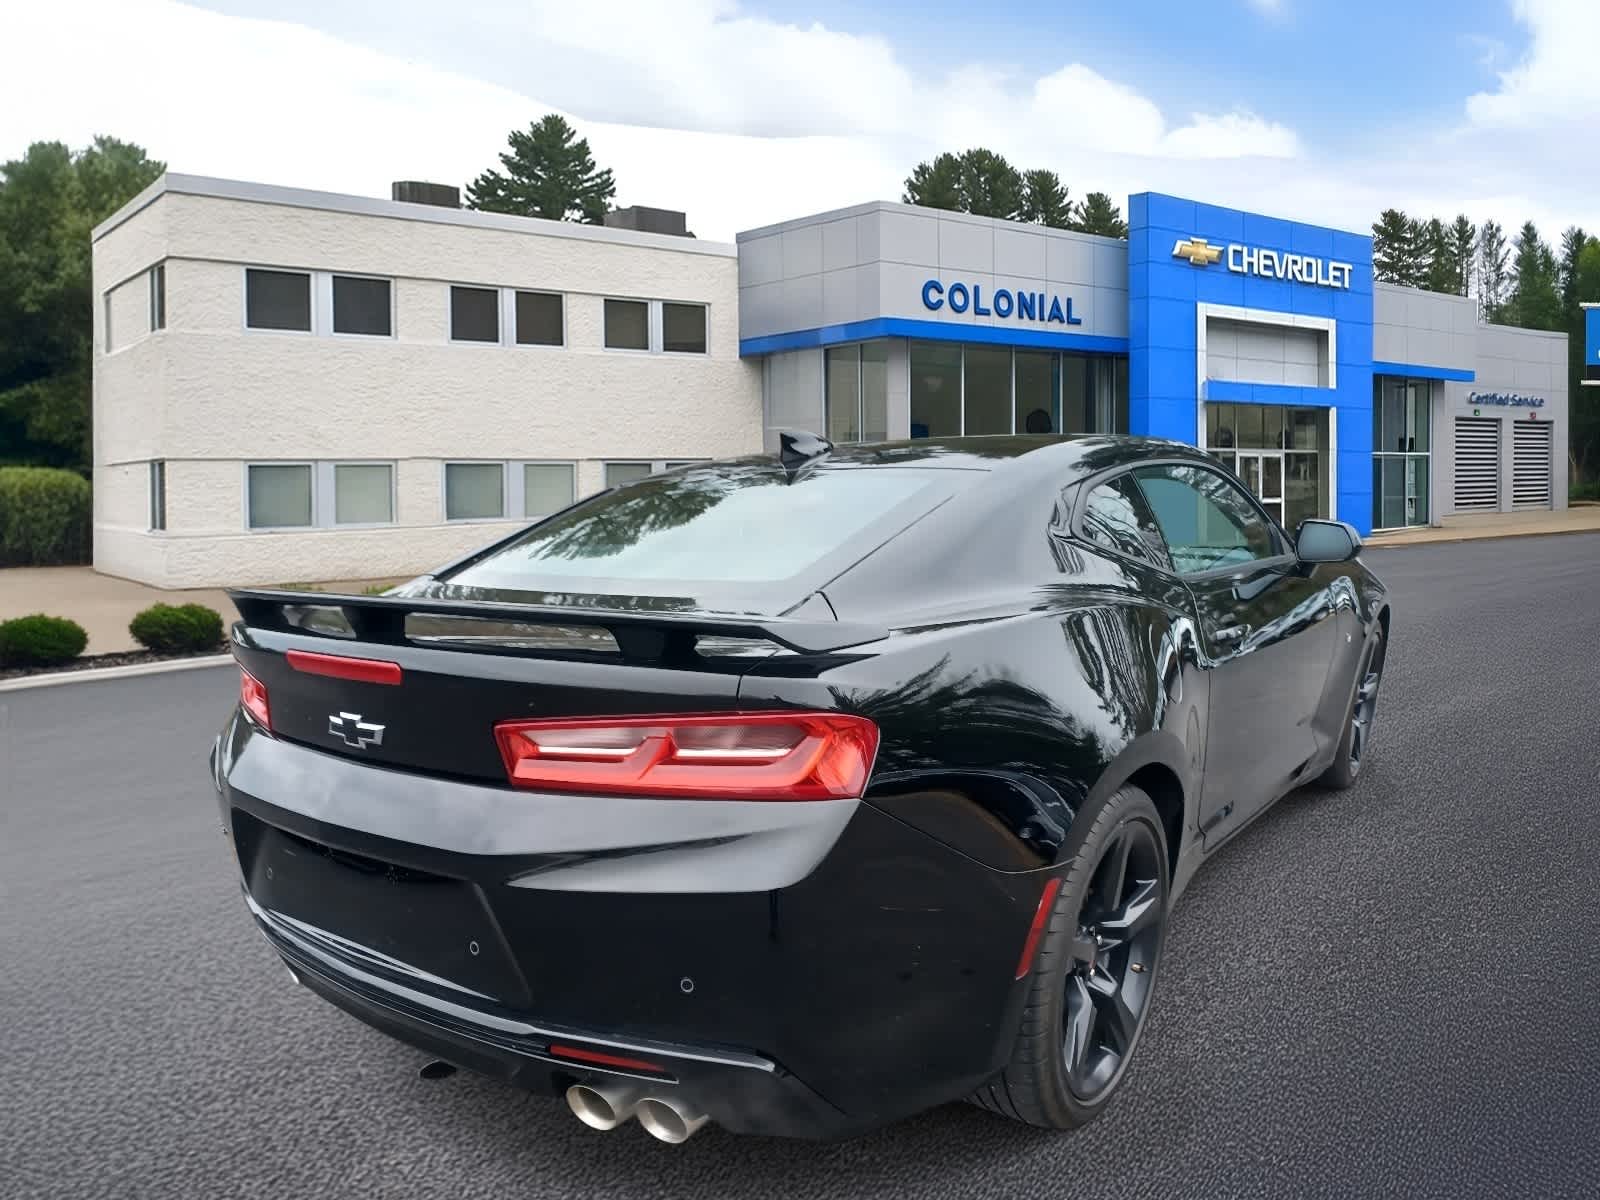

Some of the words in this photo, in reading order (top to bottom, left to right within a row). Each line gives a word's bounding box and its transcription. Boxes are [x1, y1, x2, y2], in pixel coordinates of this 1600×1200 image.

[1228, 243, 1353, 289] CHEVROLET
[922, 279, 1082, 325] COLONIAL
[1468, 391, 1509, 406] Certified
[1510, 394, 1544, 407] Service
